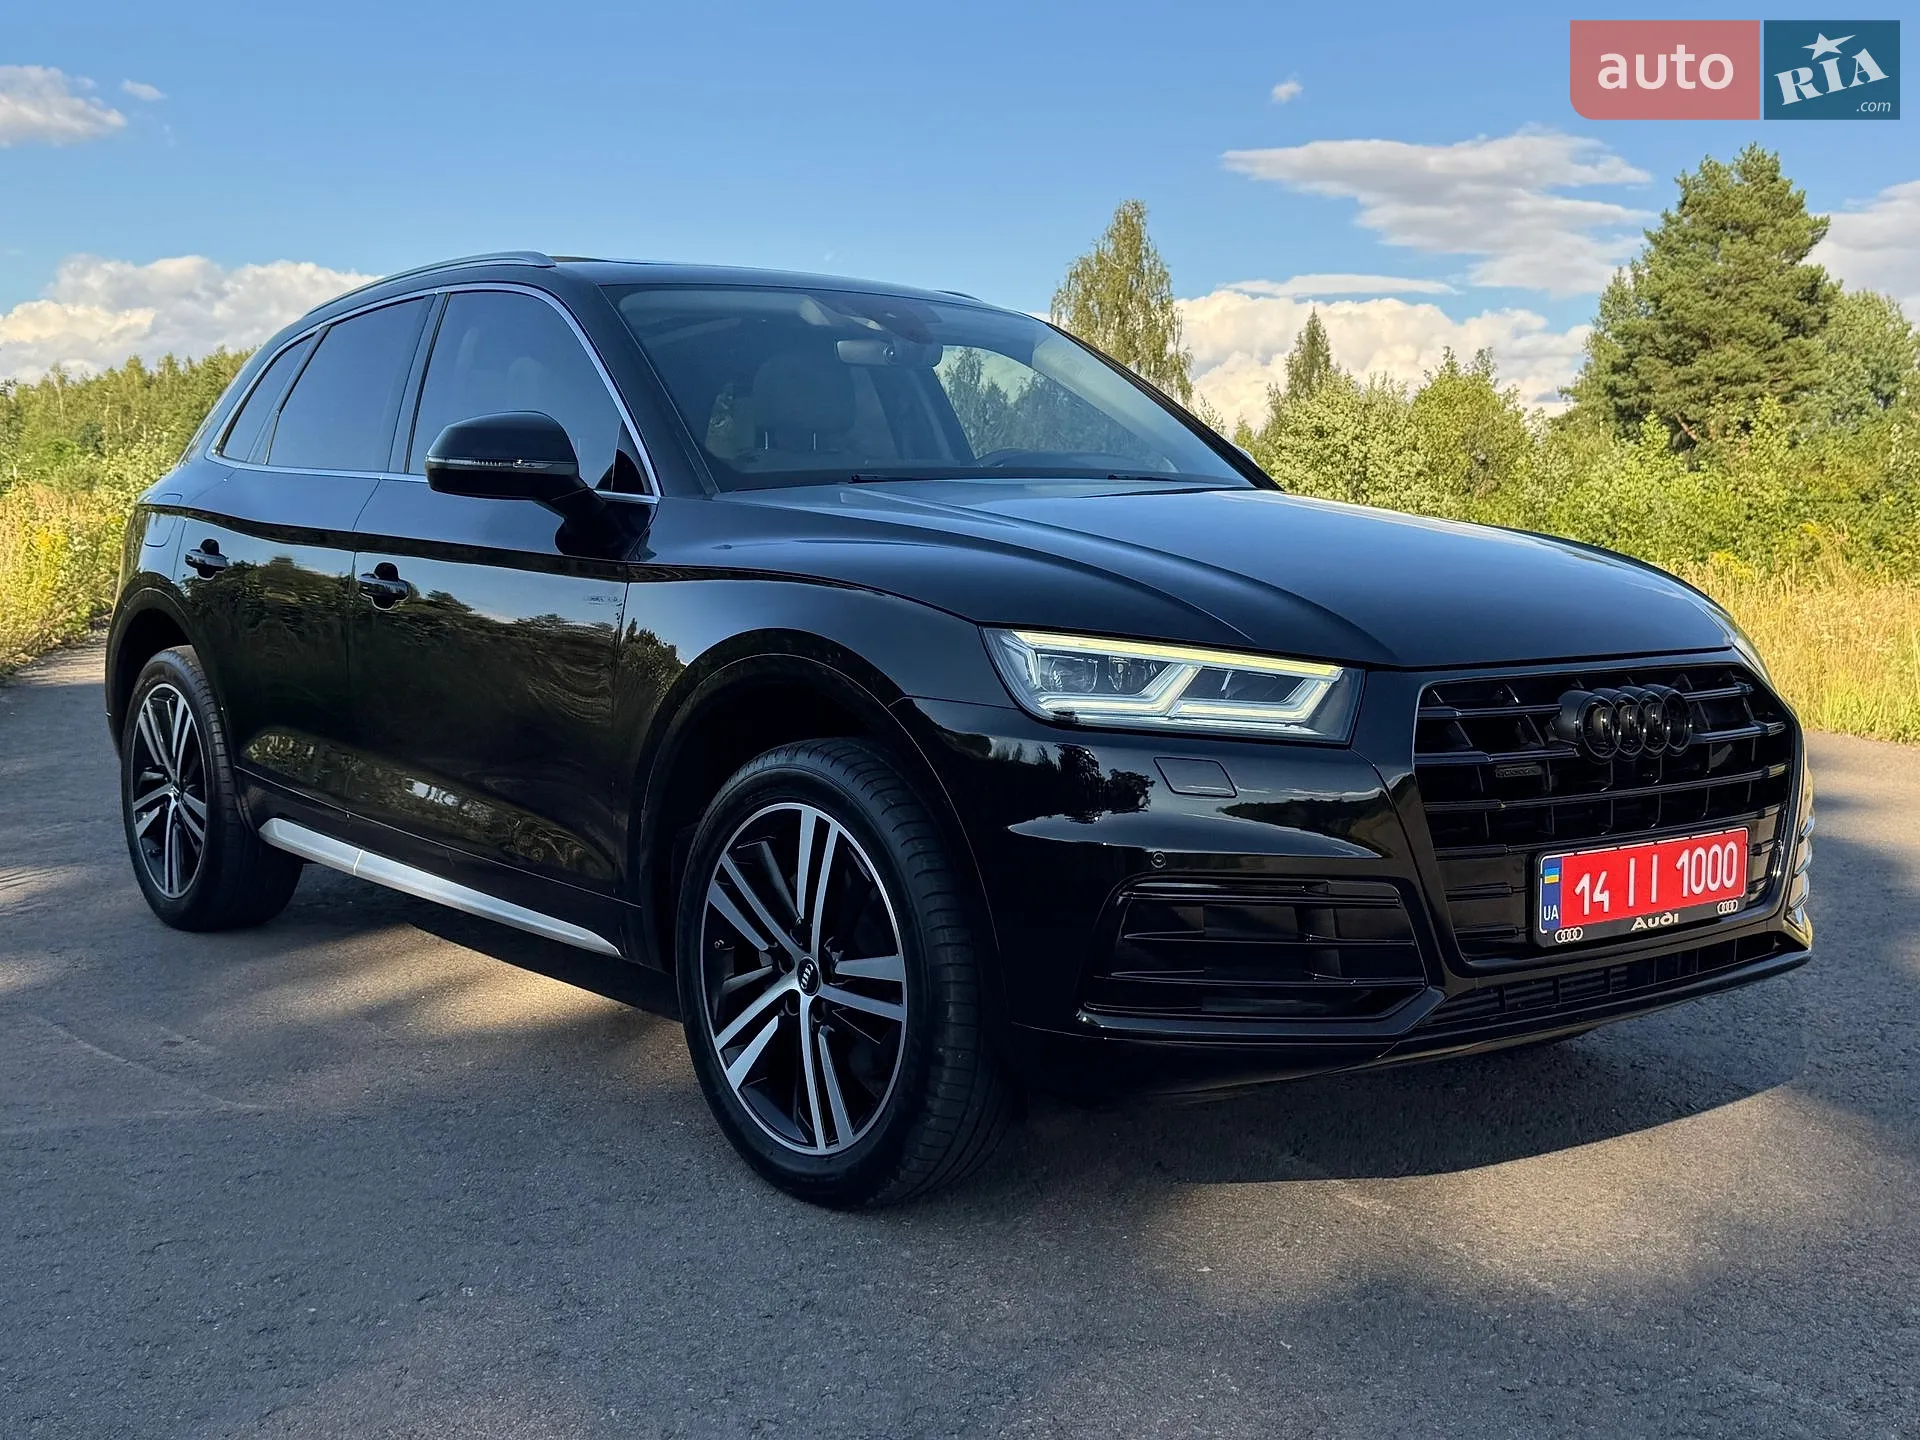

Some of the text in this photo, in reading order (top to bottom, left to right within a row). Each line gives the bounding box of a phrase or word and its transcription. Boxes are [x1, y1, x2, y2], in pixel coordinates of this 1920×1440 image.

[1574, 870, 1610, 916] 14
[1675, 841, 1738, 898] 1000
[1543, 906, 1559, 921] UA
[1631, 912, 1679, 931] Audi
